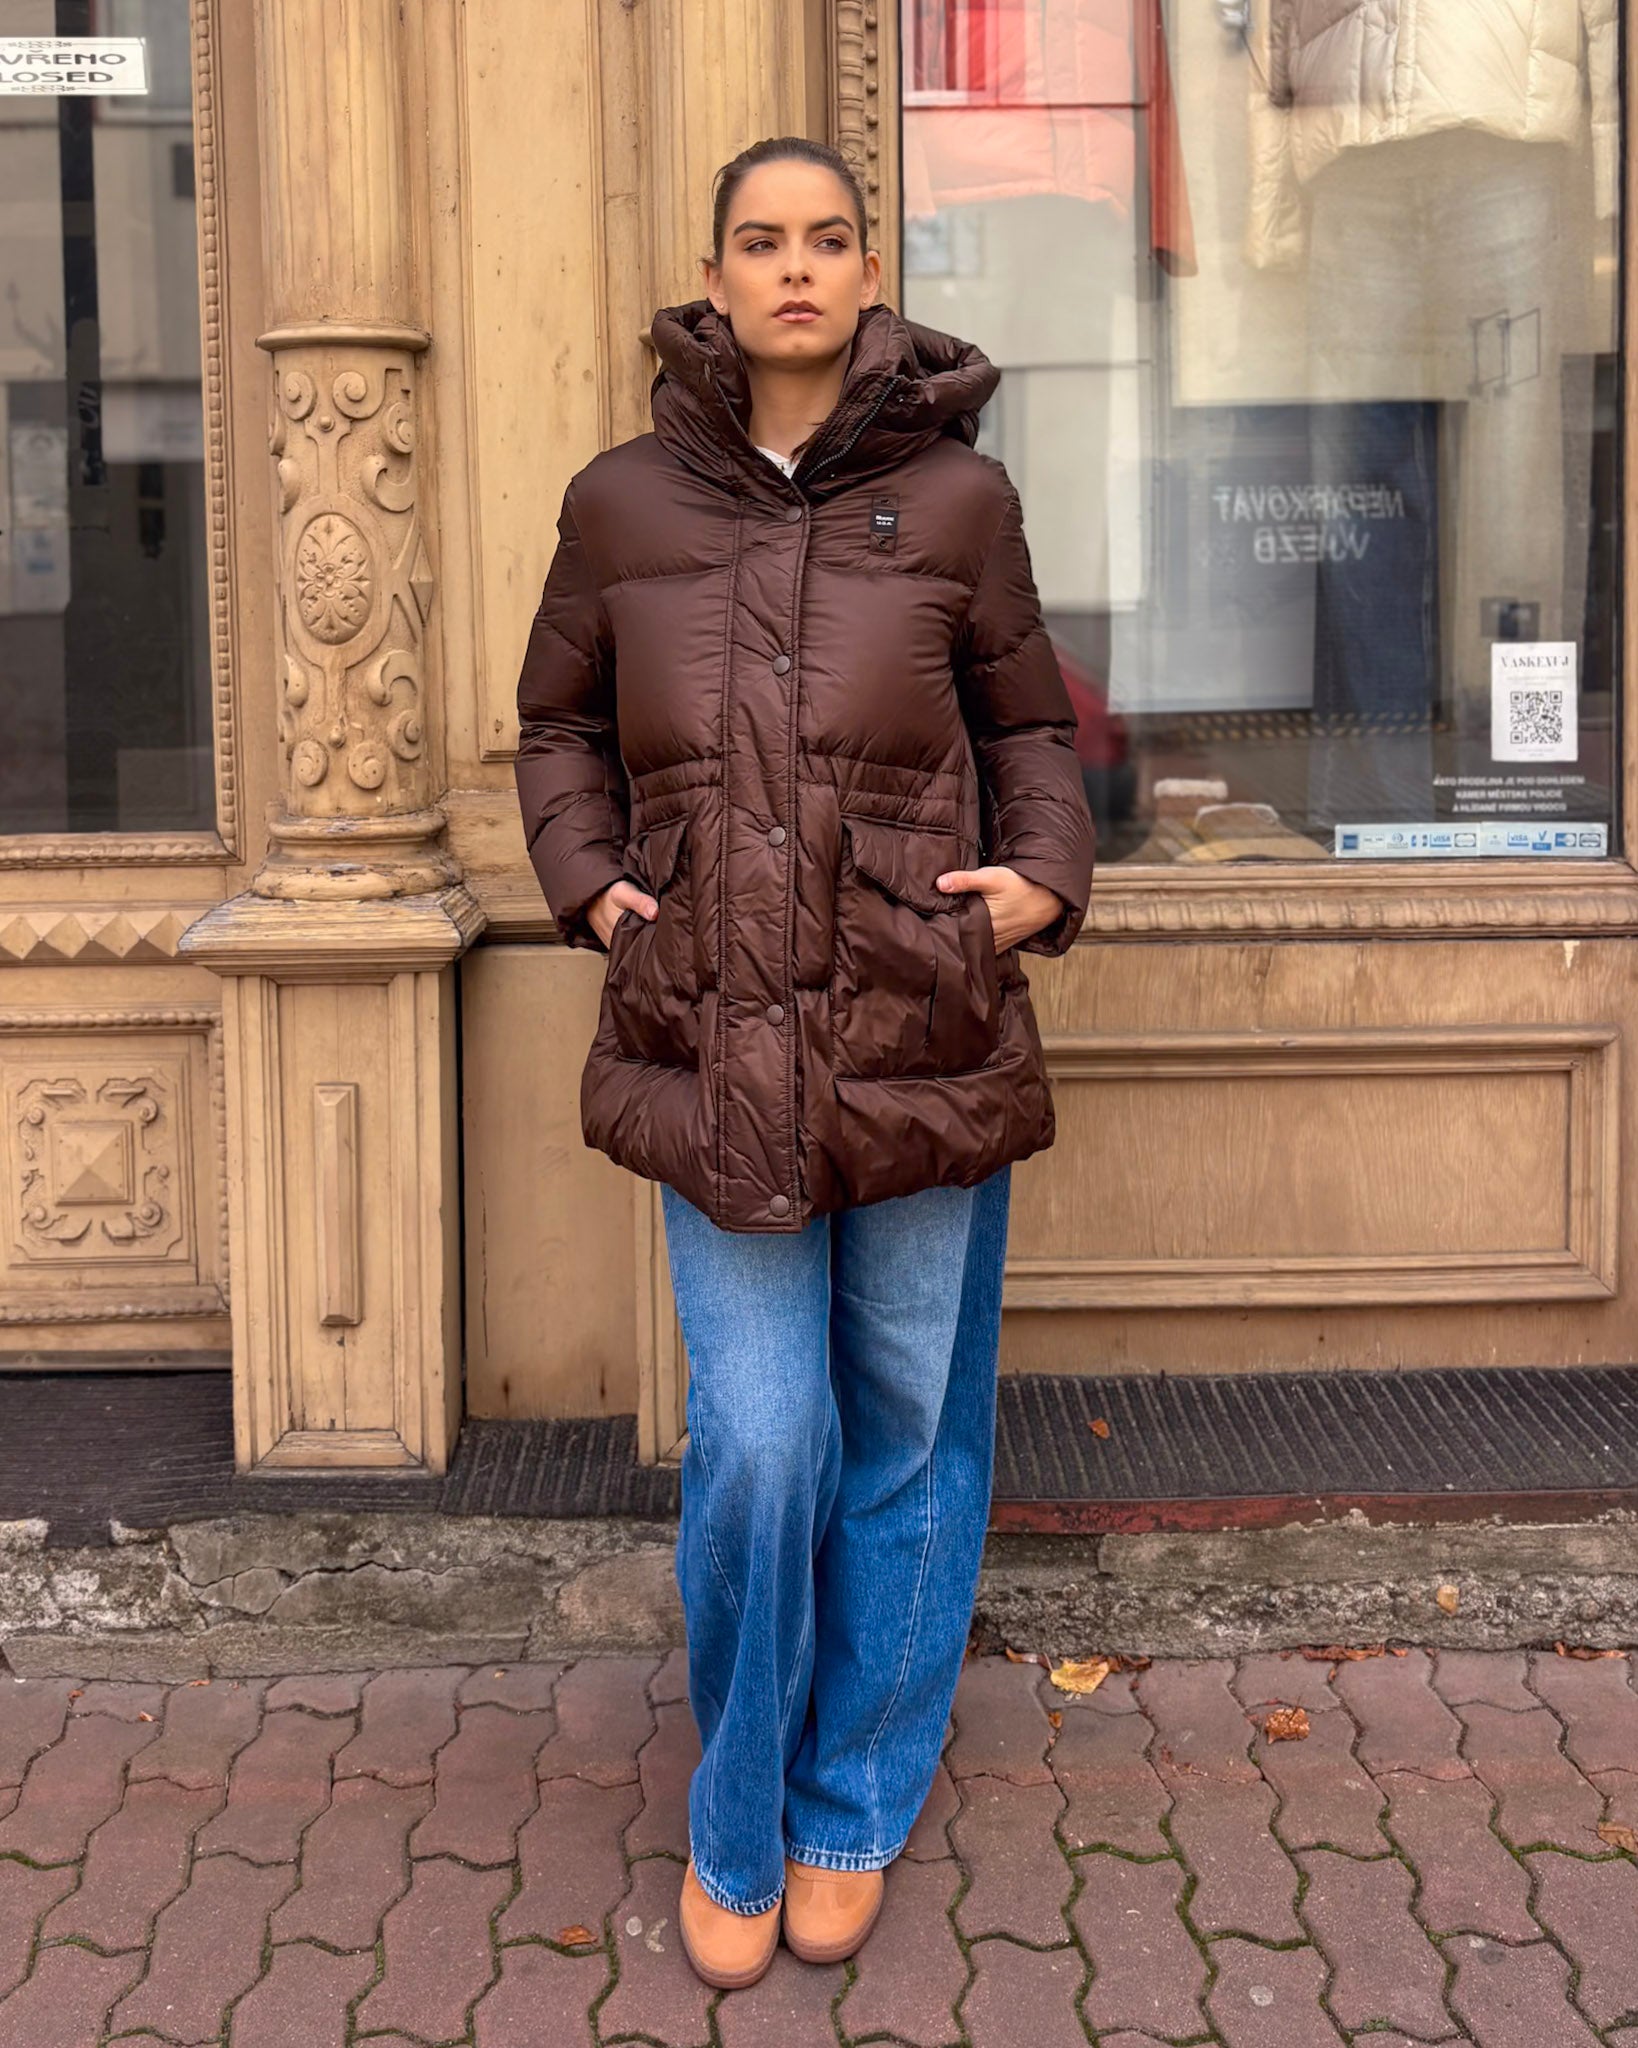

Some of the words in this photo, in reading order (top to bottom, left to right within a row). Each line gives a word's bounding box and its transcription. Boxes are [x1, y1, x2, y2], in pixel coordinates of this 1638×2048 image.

[0, 49, 126, 65] VŘENO
[1433, 834, 1451, 842] VISA
[1510, 834, 1528, 842] VISA
